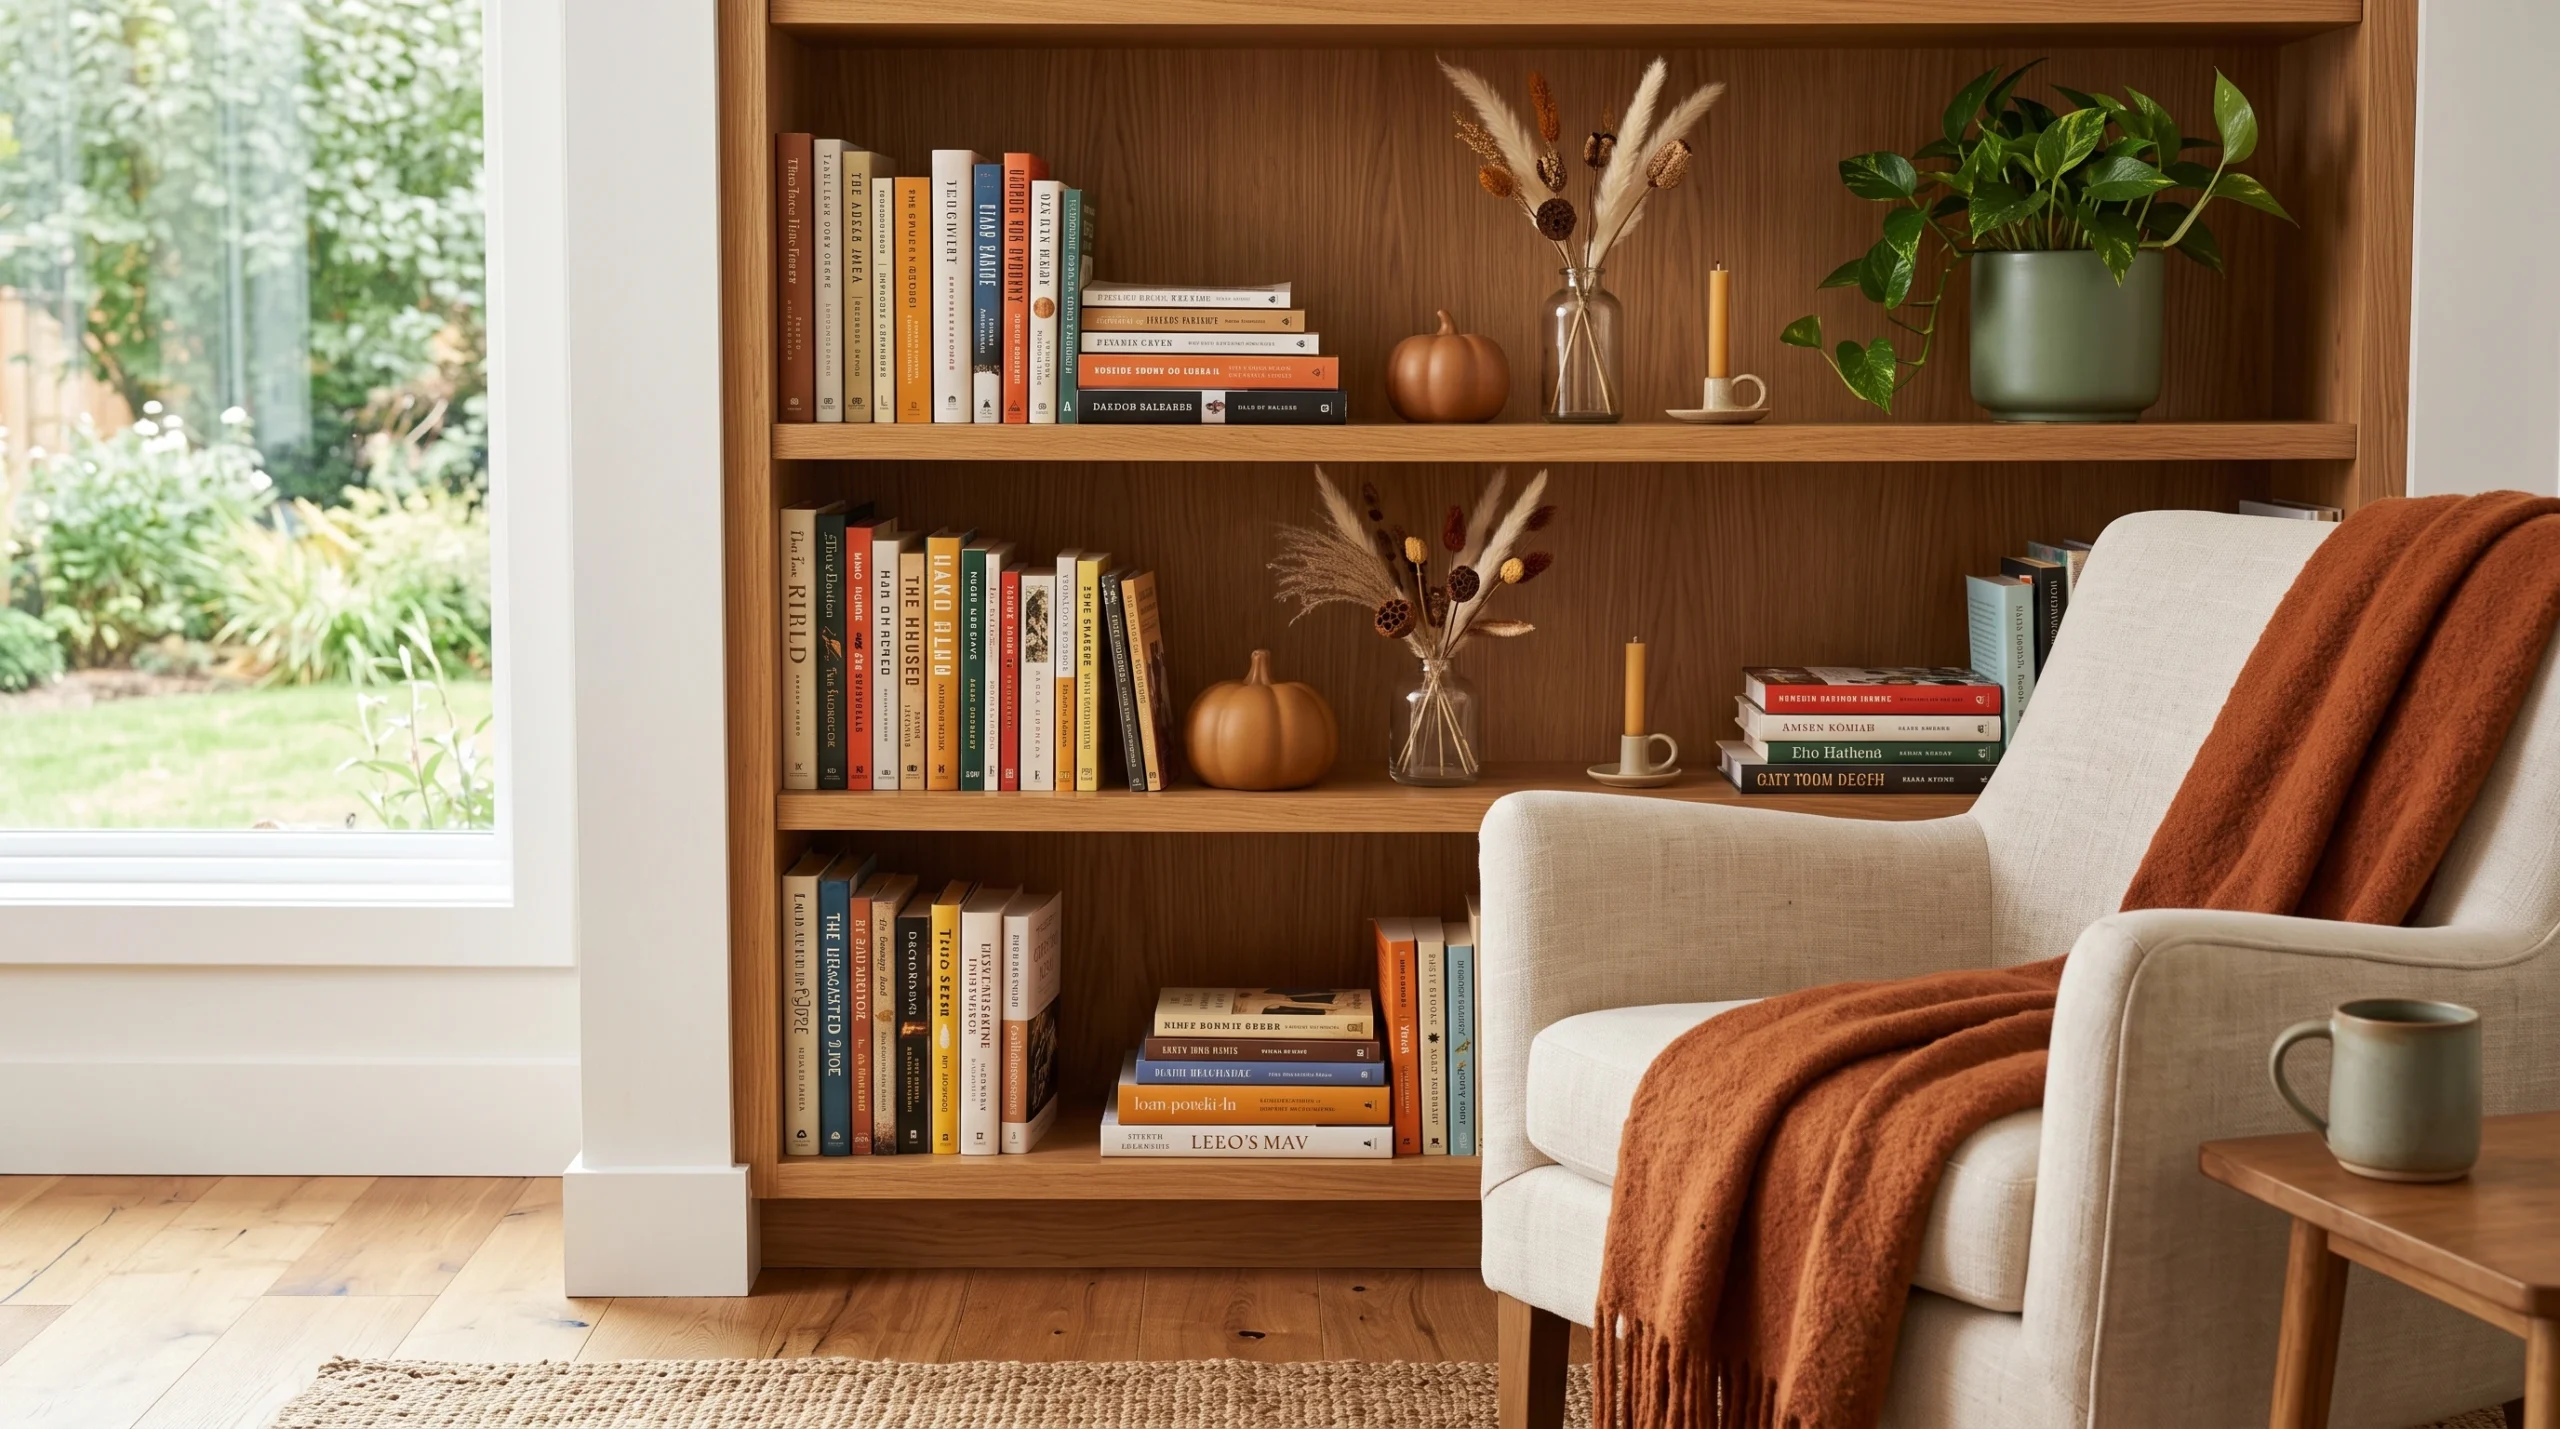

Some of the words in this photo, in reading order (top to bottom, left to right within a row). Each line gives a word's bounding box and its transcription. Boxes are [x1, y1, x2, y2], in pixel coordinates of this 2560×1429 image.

[906, 576, 919, 607] THE
[1792, 747, 1819, 758] Eho
[826, 913, 840, 940] THE
[1264, 1136, 1308, 1149] MAV
